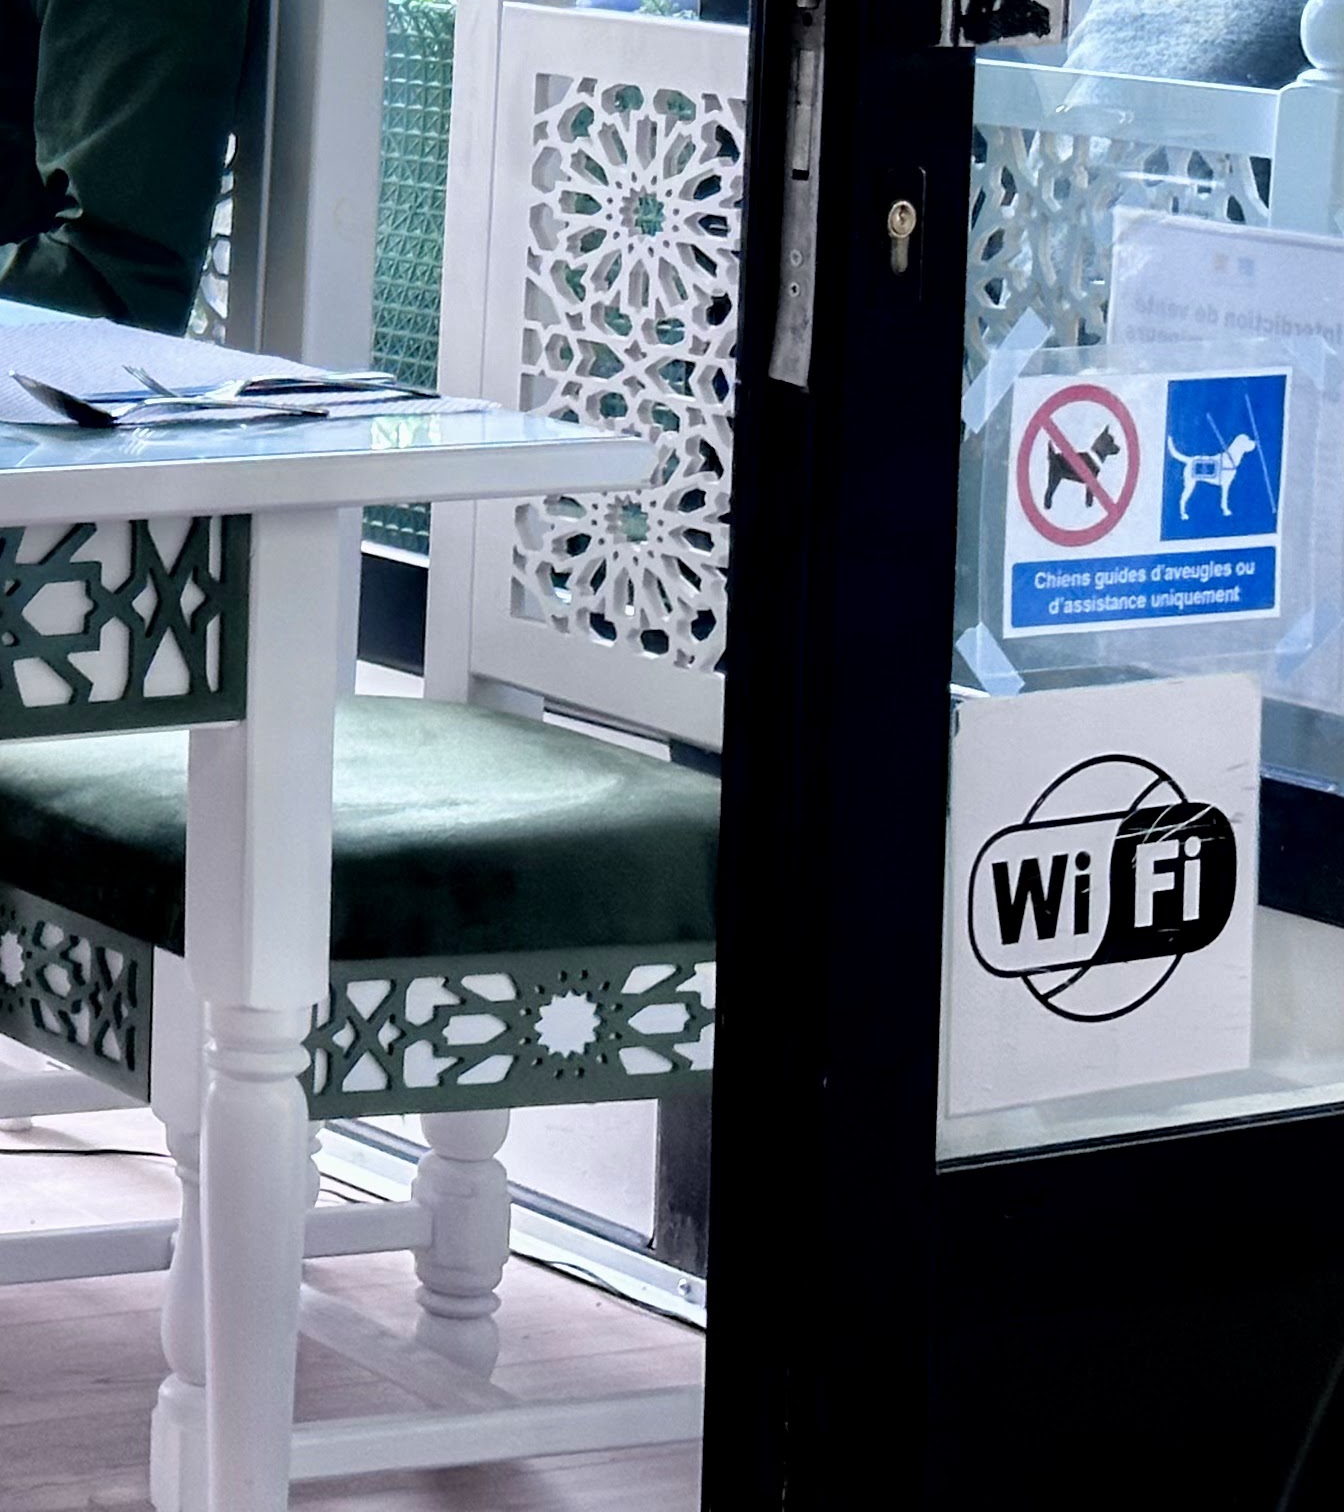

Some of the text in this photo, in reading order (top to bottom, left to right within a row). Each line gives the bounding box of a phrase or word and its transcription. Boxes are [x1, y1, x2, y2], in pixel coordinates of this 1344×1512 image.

[1034, 559, 1256, 591] Chiens guides d'aveugles ou
[1048, 585, 1241, 615] d'assistance uniquement
